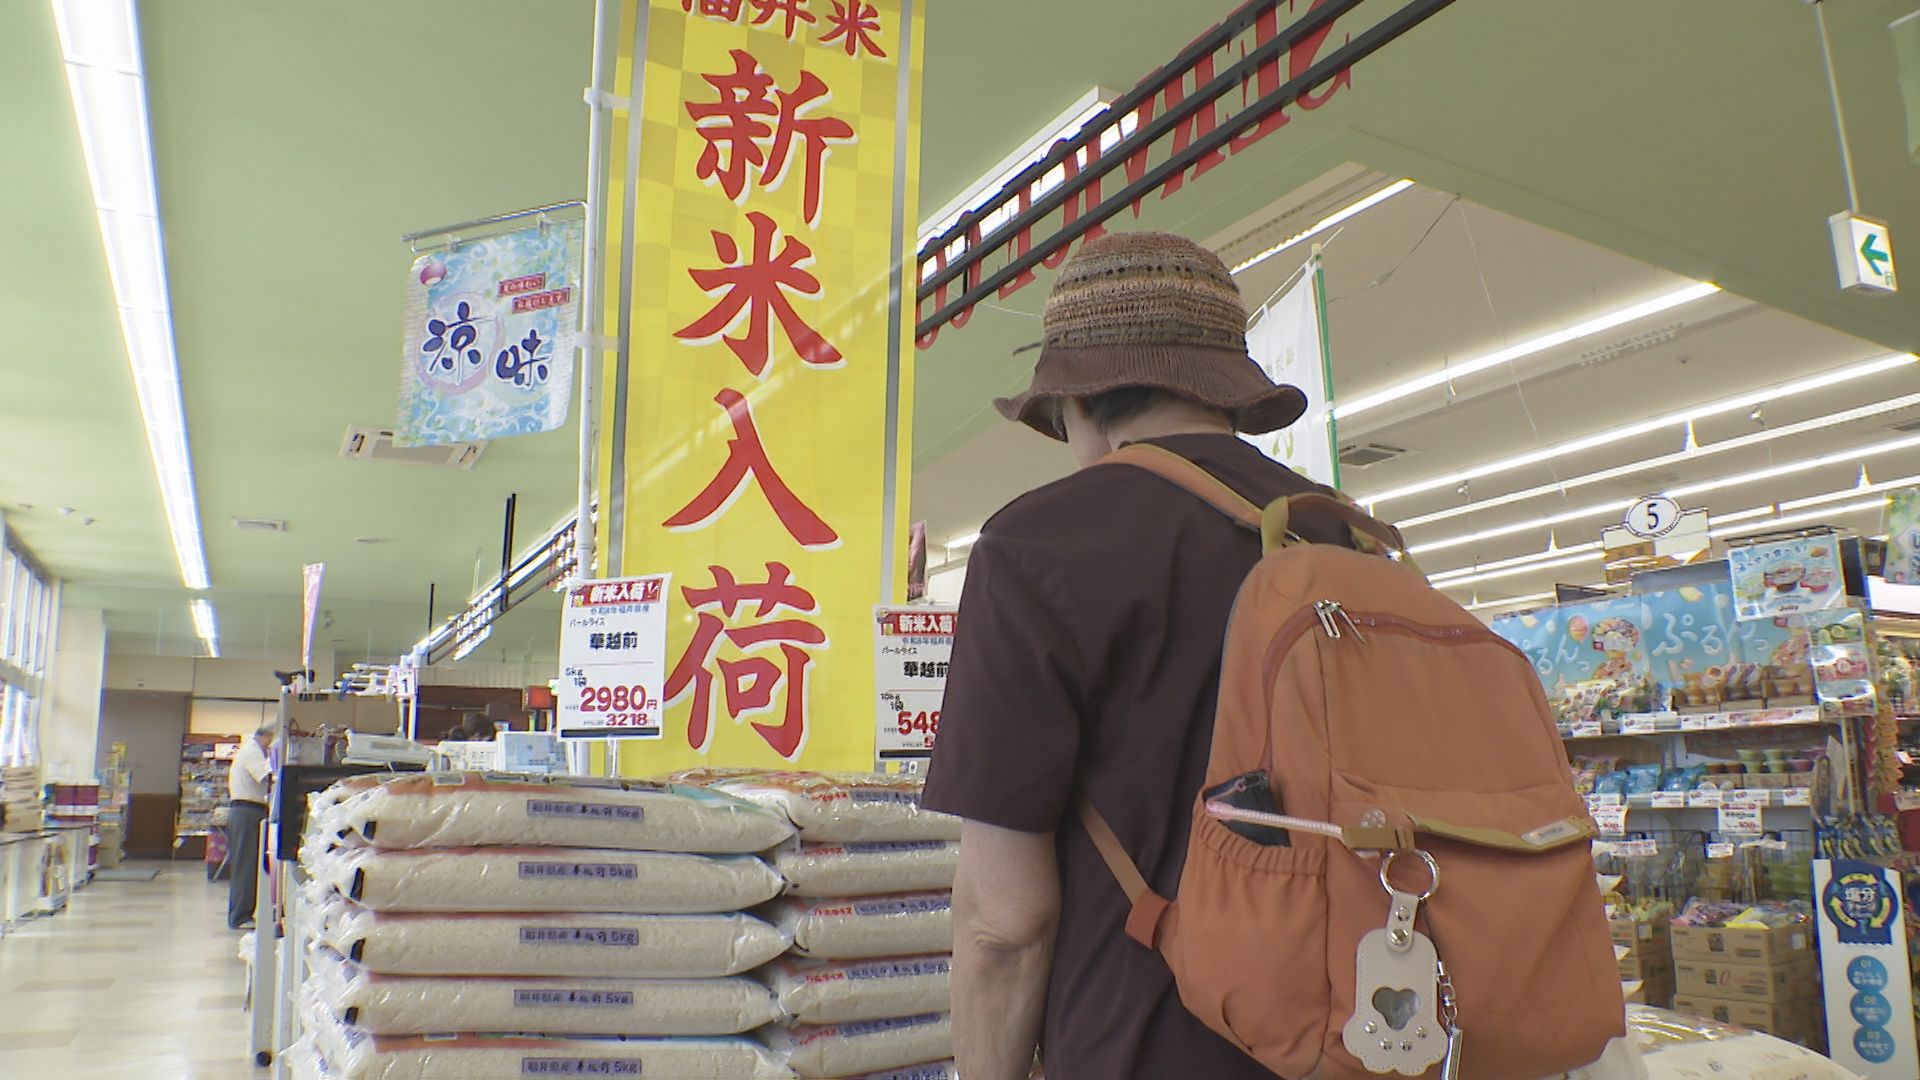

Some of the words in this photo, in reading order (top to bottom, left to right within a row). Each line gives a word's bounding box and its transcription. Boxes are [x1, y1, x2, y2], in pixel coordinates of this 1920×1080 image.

[662, 49, 855, 758] 新米入荷
[1647, 503, 1659, 530] 5
[899, 614, 958, 633] 新米入荷
[589, 631, 638, 650] 華越前
[898, 711, 942, 736] 548
